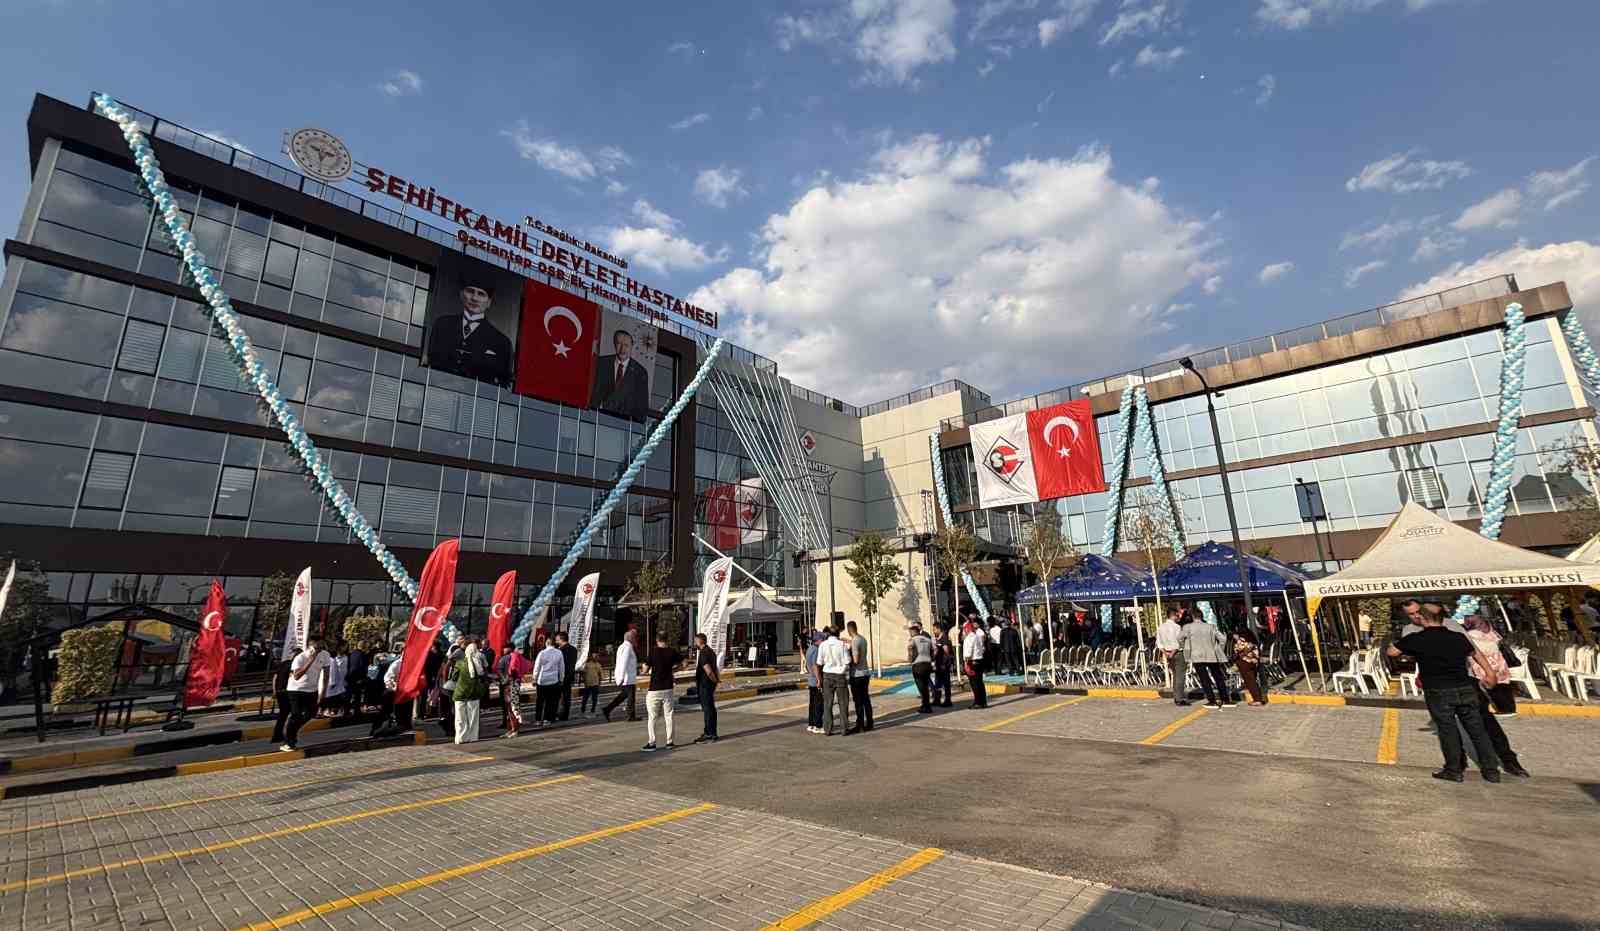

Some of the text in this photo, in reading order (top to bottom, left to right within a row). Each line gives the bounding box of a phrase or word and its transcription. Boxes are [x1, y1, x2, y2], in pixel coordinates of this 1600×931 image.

[367, 167, 718, 329] ŞEHİTKAMİL DEVLET HASTANESİ
[457, 229, 531, 268] Gaziantep
[1319, 571, 1583, 595] GAZİANTEP BÜYÜKŞEHİR BELEDİYESİ
